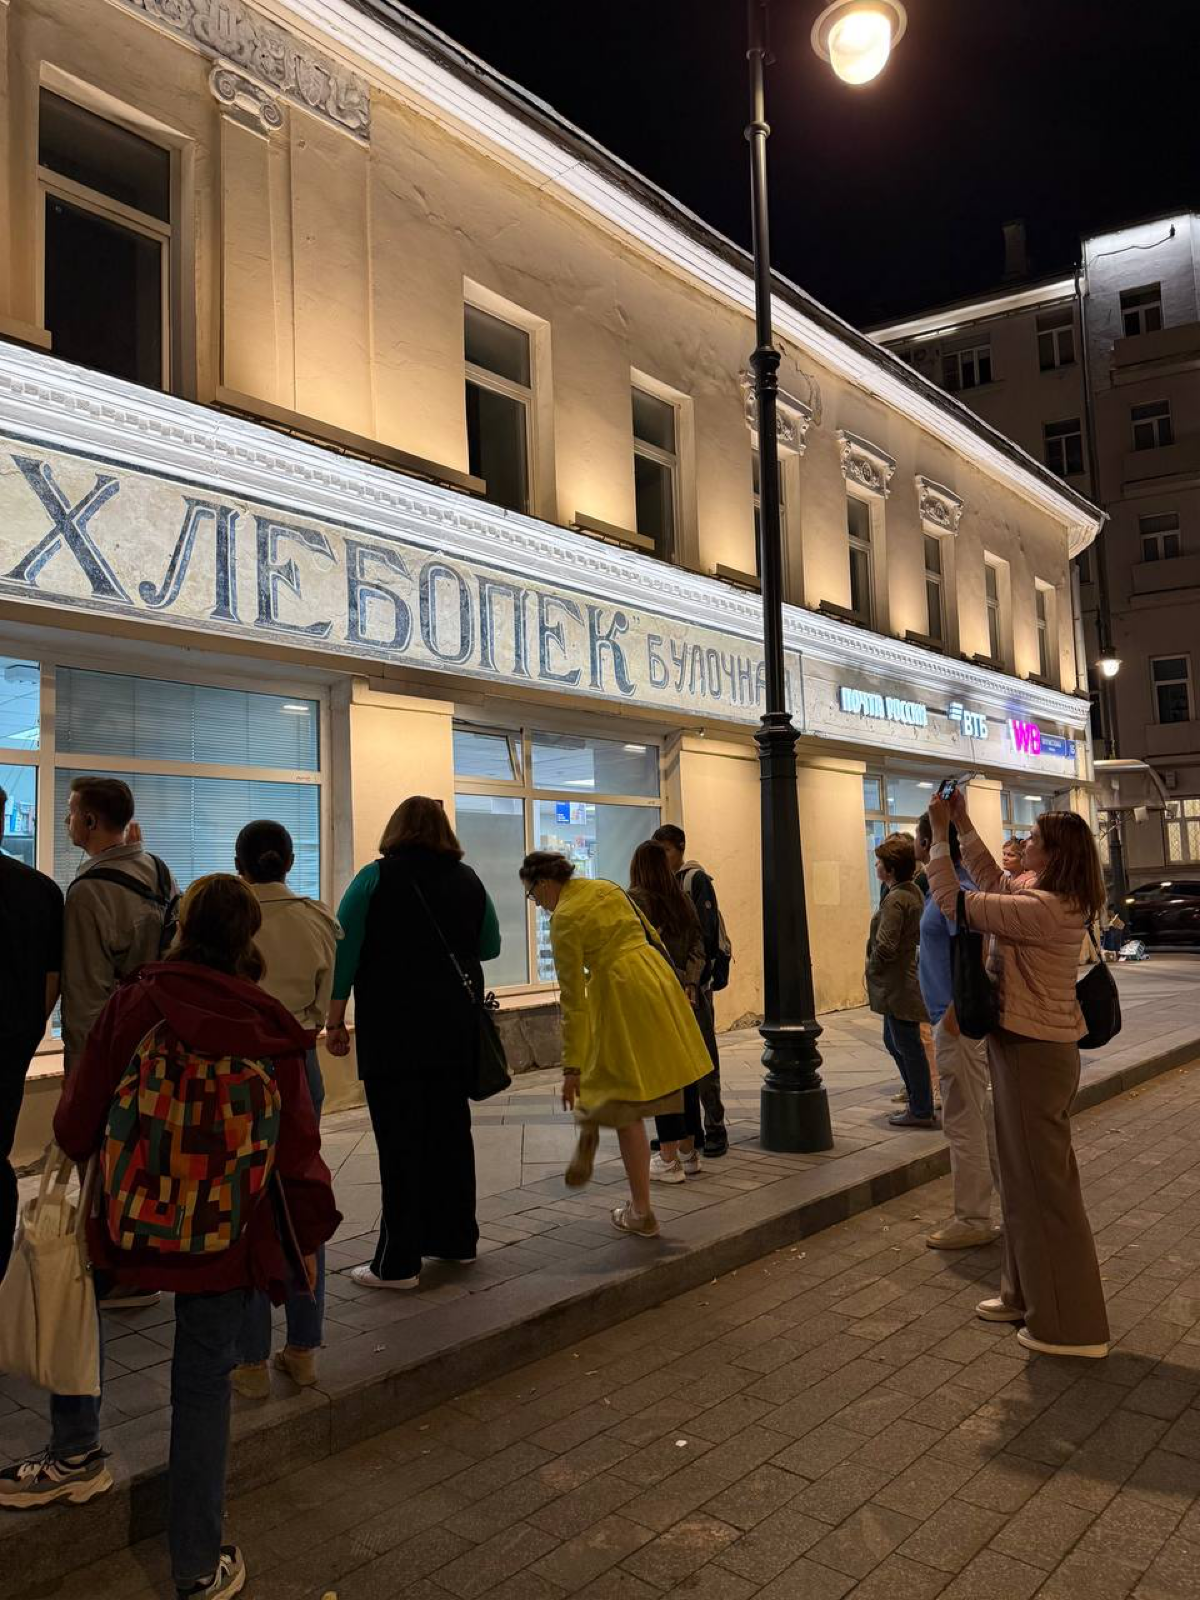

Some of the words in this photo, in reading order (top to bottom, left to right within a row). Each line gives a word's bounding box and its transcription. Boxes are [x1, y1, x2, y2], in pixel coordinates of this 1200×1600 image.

[839, 686, 886, 719] ПОЧТА
[961, 710, 988, 739] ВТБ
[1009, 719, 1041, 756] WB
